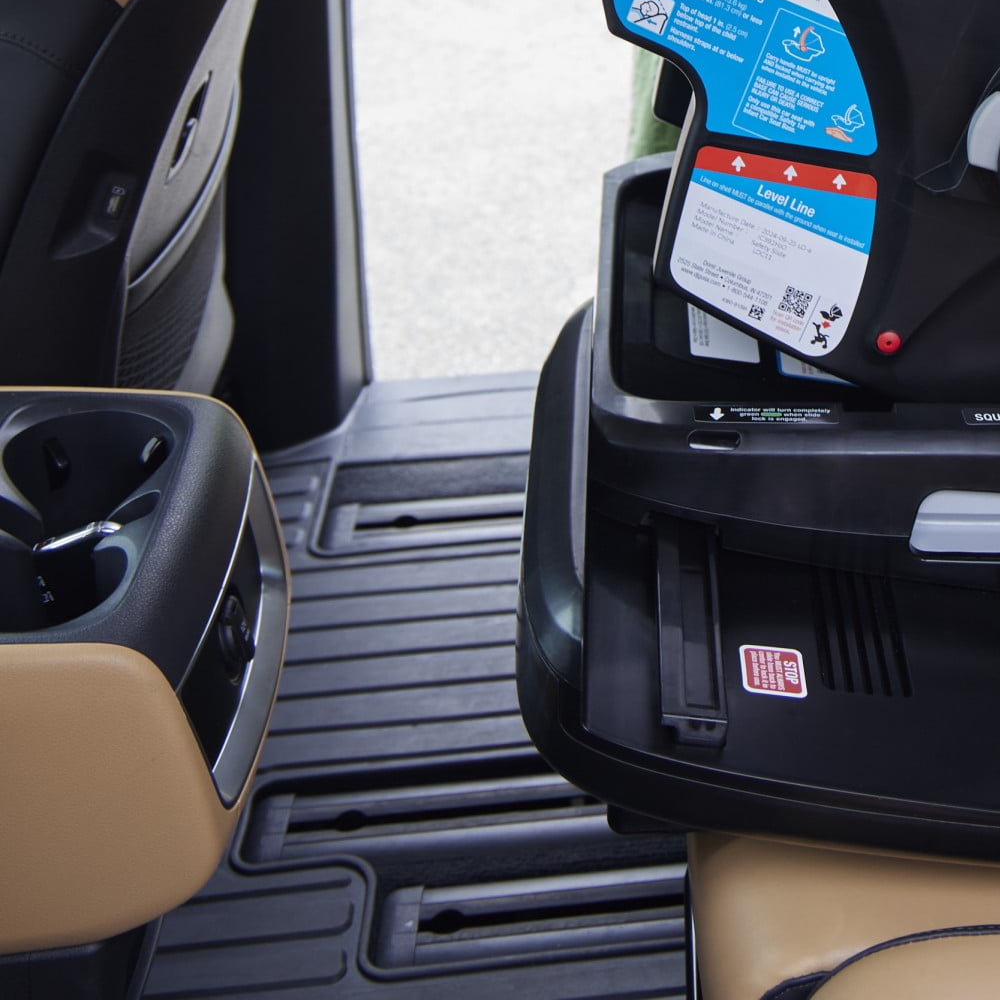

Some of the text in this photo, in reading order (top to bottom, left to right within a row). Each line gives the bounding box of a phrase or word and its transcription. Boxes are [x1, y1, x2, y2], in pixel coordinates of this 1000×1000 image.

[675, 9, 694, 22] below
[693, 17, 705, 28] top
[711, 25, 722, 34] the
[721, 29, 736, 40] child
[678, 2, 690, 12] Top
[697, 10, 712, 21] head
[716, 19, 725, 27] in.
[724, 22, 737, 33] (2.5
[714, 0, 730, 12] (81.3
[749, 15, 763, 25] less
[669, 26, 694, 41] Harness
[692, 36, 712, 50] straps
[725, 51, 744, 63] below
[796, 65, 810, 74] MUST
[756, 184, 817, 217] Level Line
[784, 660, 799, 684] STOP
